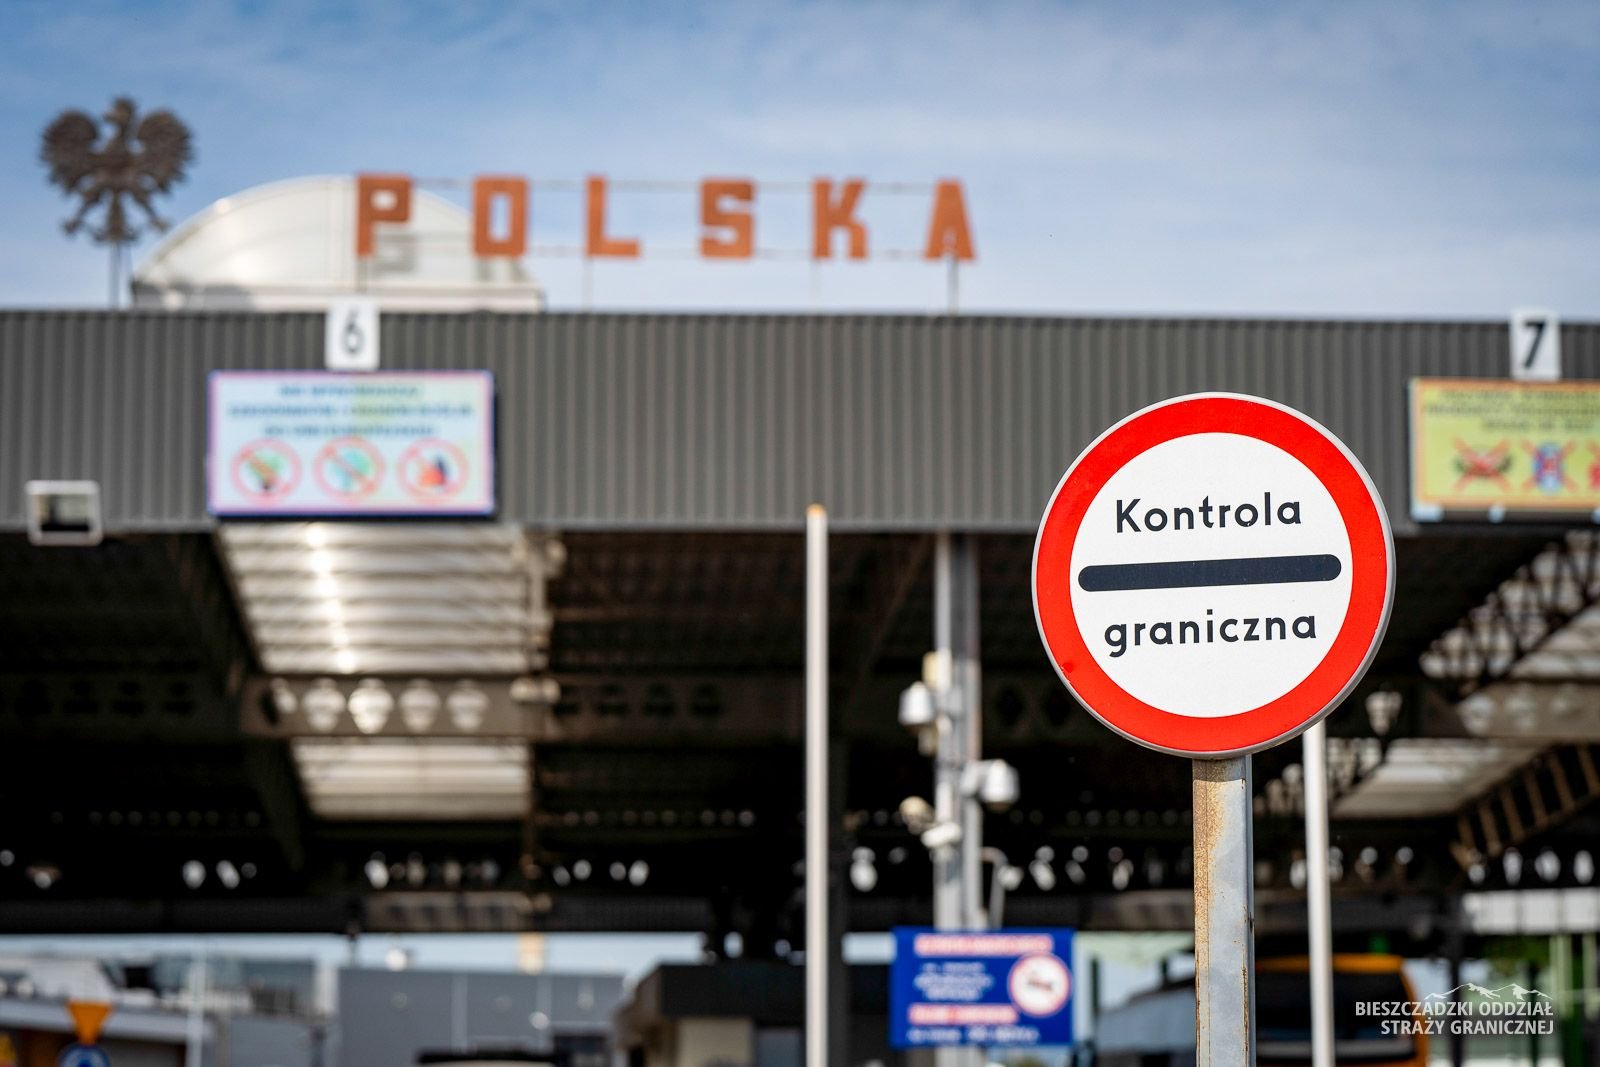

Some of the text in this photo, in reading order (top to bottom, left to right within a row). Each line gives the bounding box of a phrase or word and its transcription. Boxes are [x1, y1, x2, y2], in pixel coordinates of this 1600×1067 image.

[355, 174, 977, 261] POLSKA
[341, 307, 364, 355] 6
[1523, 320, 1547, 369] 7
[1116, 491, 1302, 533] Kontrola
[1104, 608, 1317, 658] graniczna
